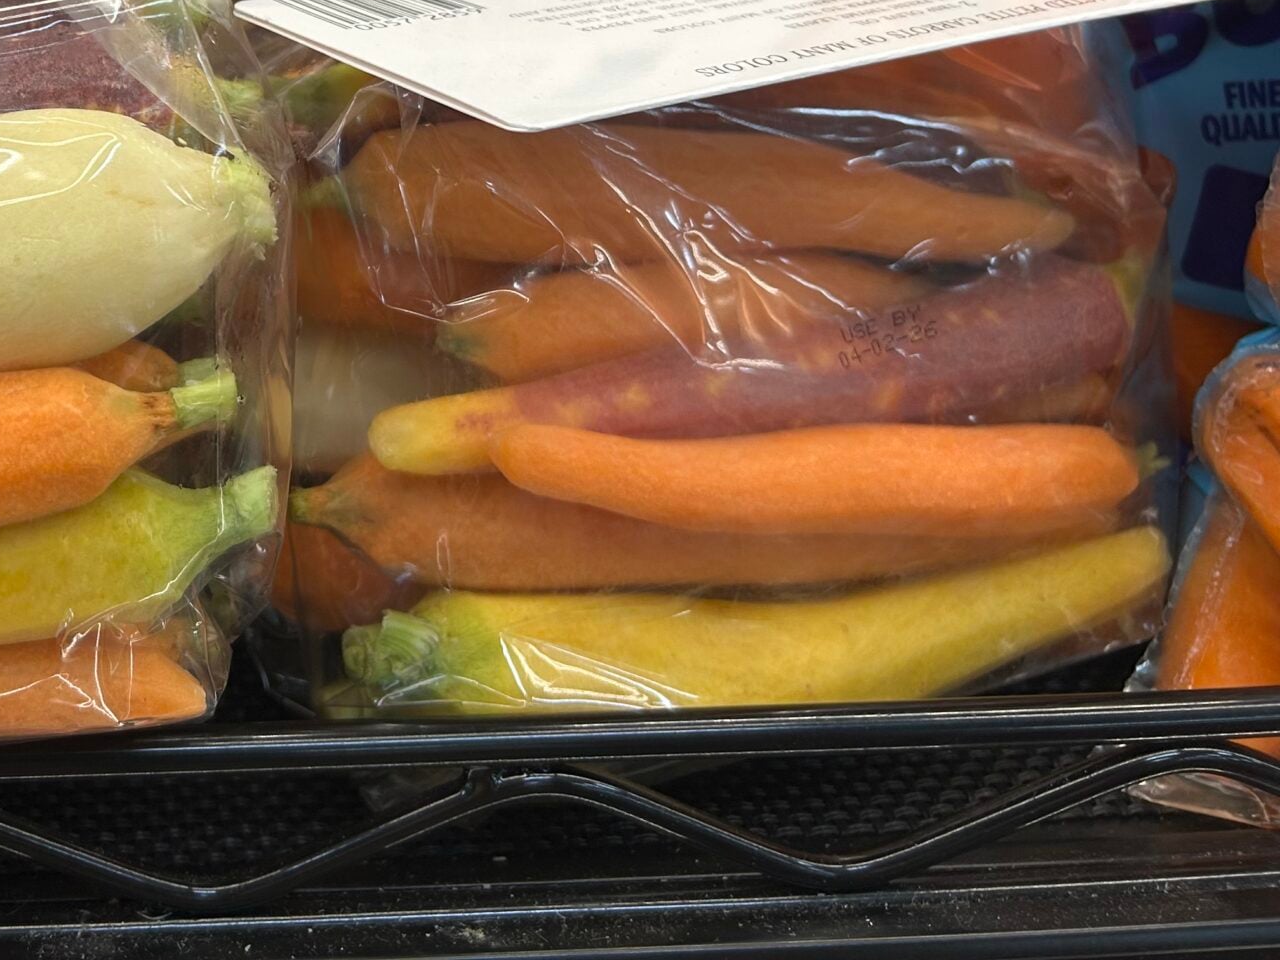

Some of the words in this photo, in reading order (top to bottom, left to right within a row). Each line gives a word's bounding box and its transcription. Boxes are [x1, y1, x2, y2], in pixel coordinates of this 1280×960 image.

[976, 3, 1048, 22] PETITE
[886, 17, 978, 39] CARROTS
[788, 40, 856, 58] MANY
[856, 34, 886, 45] OF
[694, 54, 788, 77] COLORS
[1223, 79, 1280, 110] FINE
[839, 318, 879, 344] USE
[890, 305, 921, 328] BY
[837, 320, 939, 370] 04-02-26
